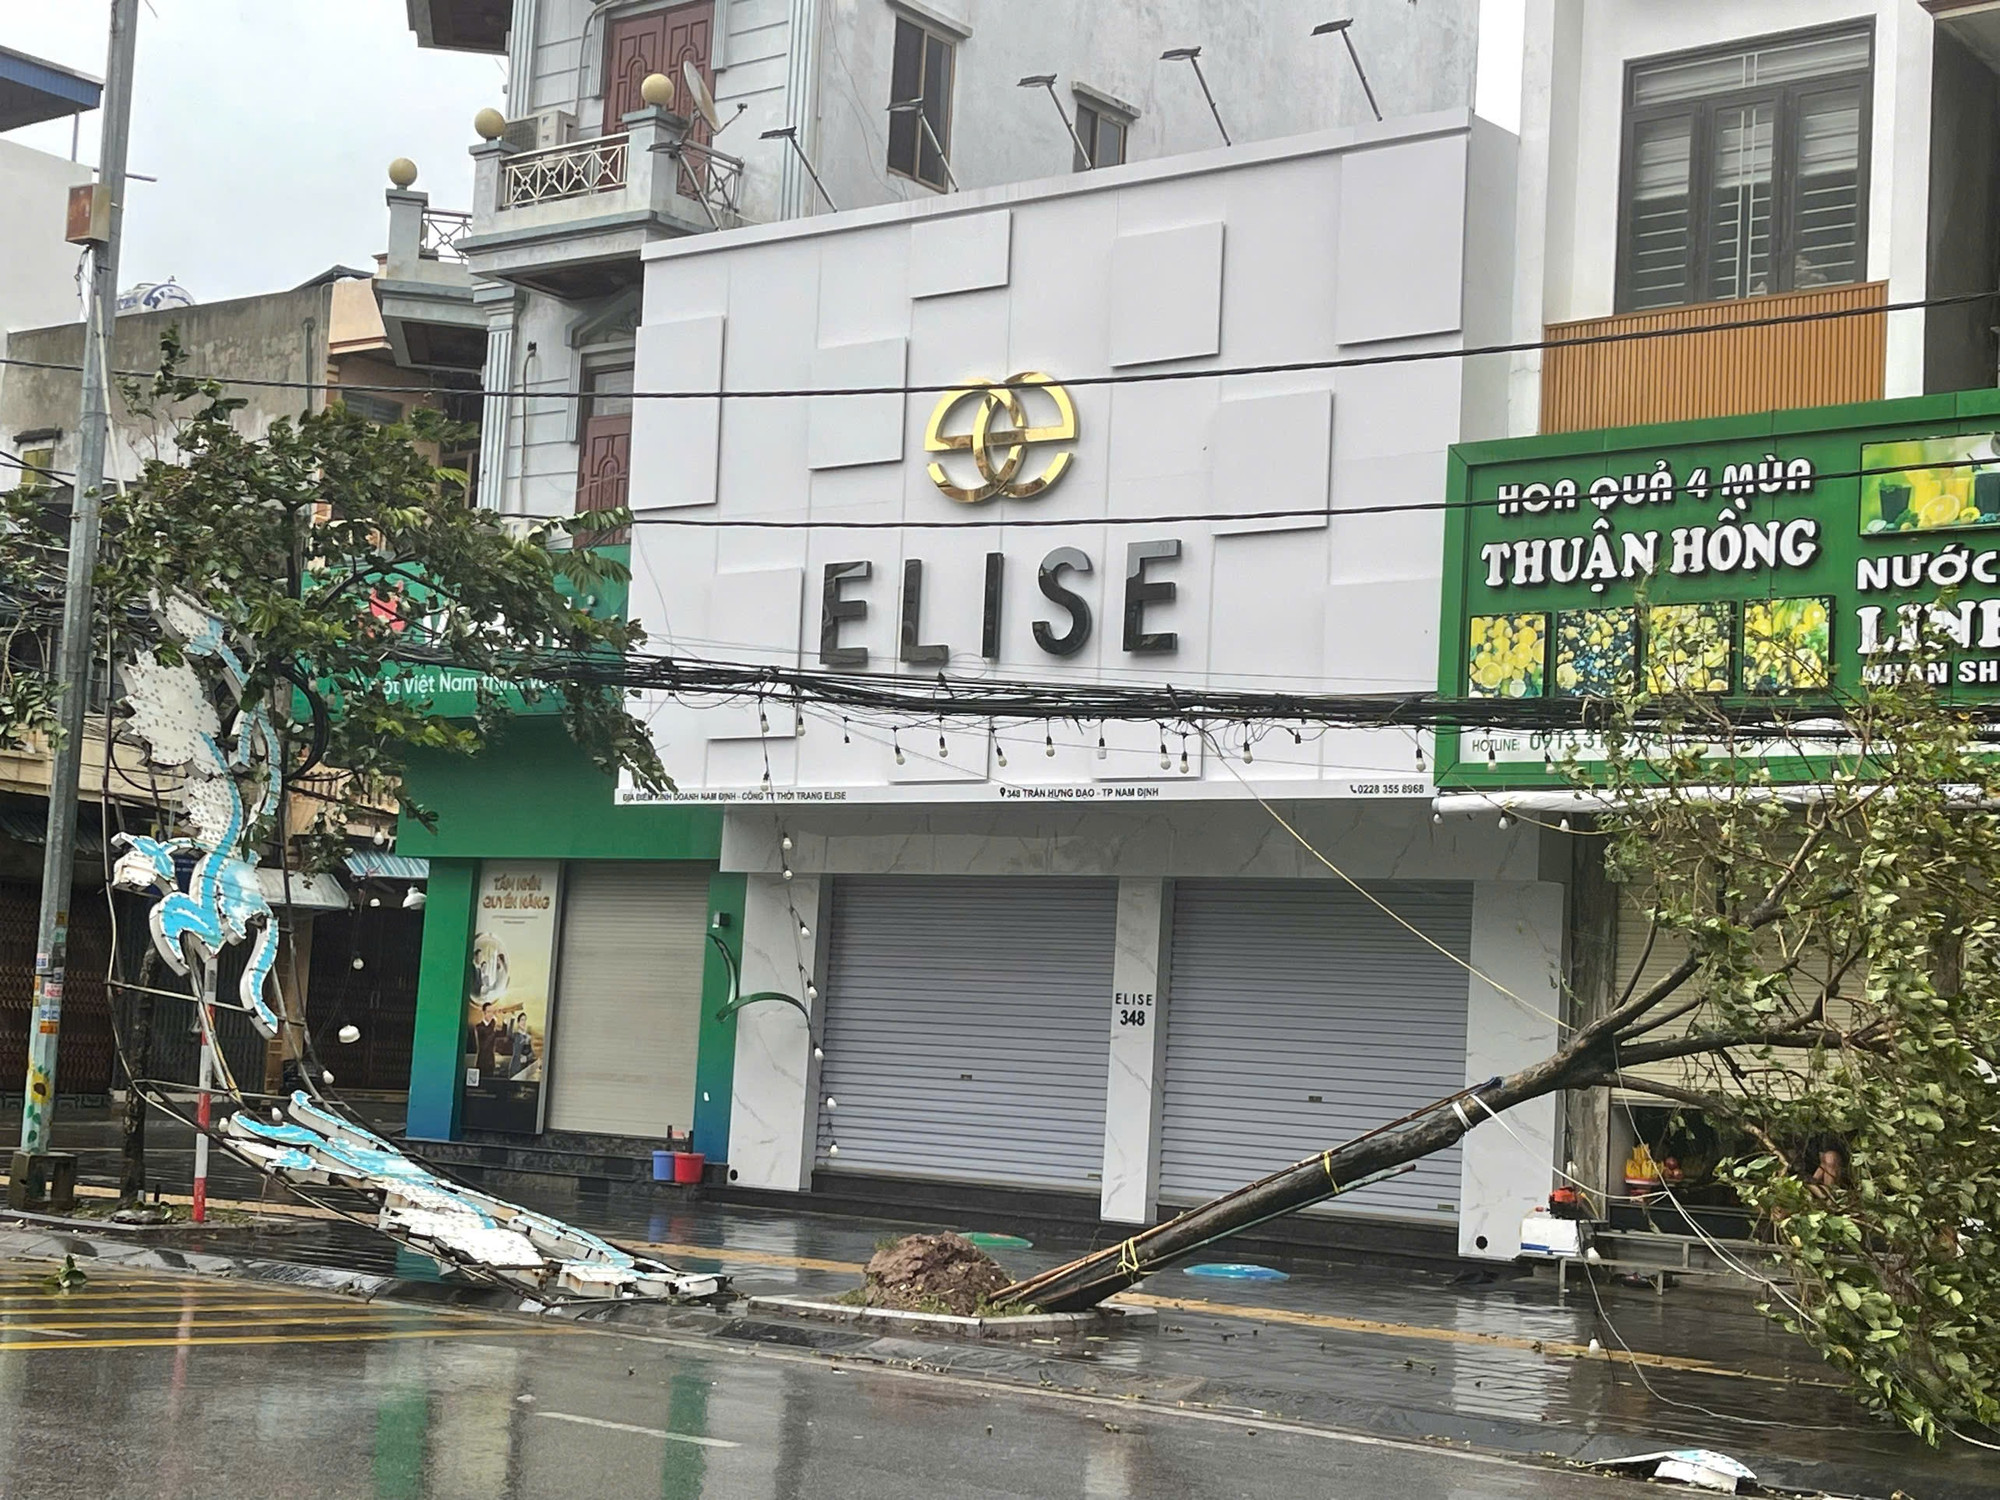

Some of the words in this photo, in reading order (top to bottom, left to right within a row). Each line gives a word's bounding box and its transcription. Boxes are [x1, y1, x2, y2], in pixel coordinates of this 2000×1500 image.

[1498, 478, 1577, 515] HOA
[1589, 459, 1674, 510] QUẢ
[1686, 467, 1708, 499] 4
[1721, 453, 1812, 496] MÙA
[1480, 516, 1659, 593] THUẬN
[1669, 496, 1818, 574] HỒNG
[1856, 543, 1998, 590] NƯỚC
[819, 538, 1182, 665] ELISE
[404, 673, 435, 699] Việt
[439, 672, 478, 693] Nam
[700, 792, 717, 800] NAM
[796, 791, 822, 800] TRANG
[824, 791, 847, 800] ELISE
[1102, 788, 1113, 797] TP
[1115, 788, 1135, 797] NAM
[1357, 784, 1380, 794] 0228
[1382, 784, 1400, 794] 355
[1115, 992, 1153, 1006] ELISE
[1119, 1009, 1146, 1027] 348
